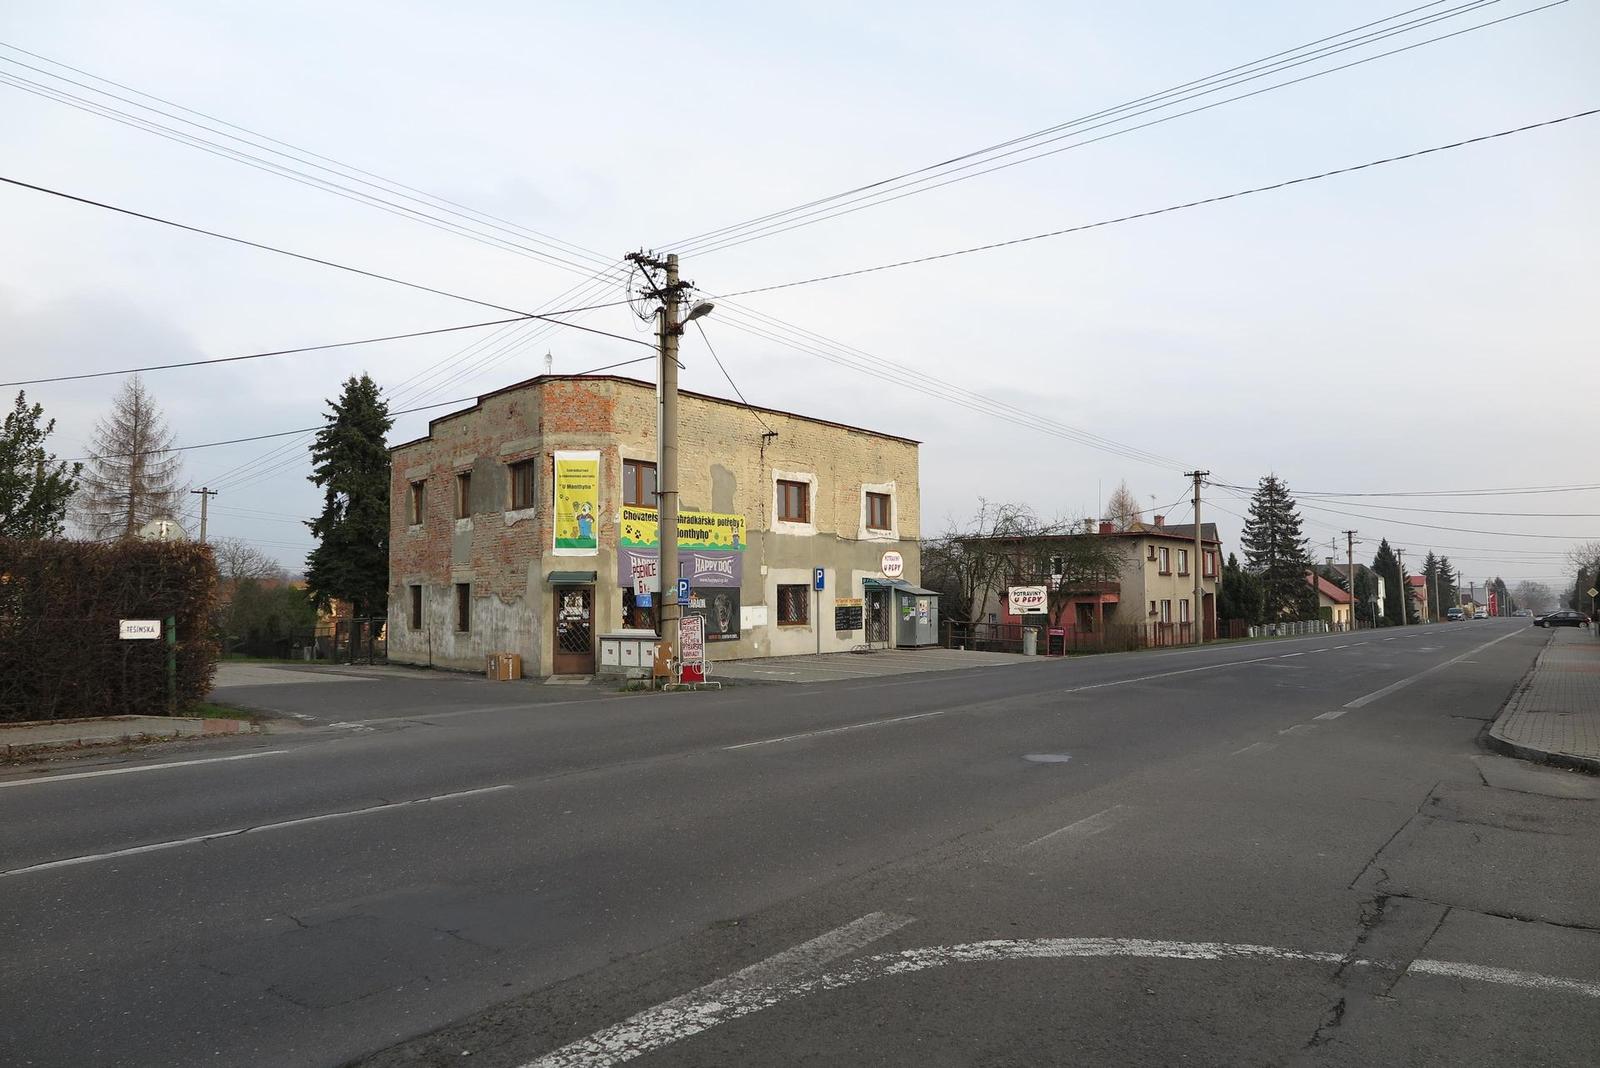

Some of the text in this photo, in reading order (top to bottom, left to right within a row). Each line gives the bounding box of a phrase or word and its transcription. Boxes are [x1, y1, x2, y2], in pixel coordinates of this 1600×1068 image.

[623, 509, 659, 522] Chovatels
[694, 557, 732, 574] HAPPY DOG
[817, 570, 823, 583] P
[680, 581, 688, 597] P
